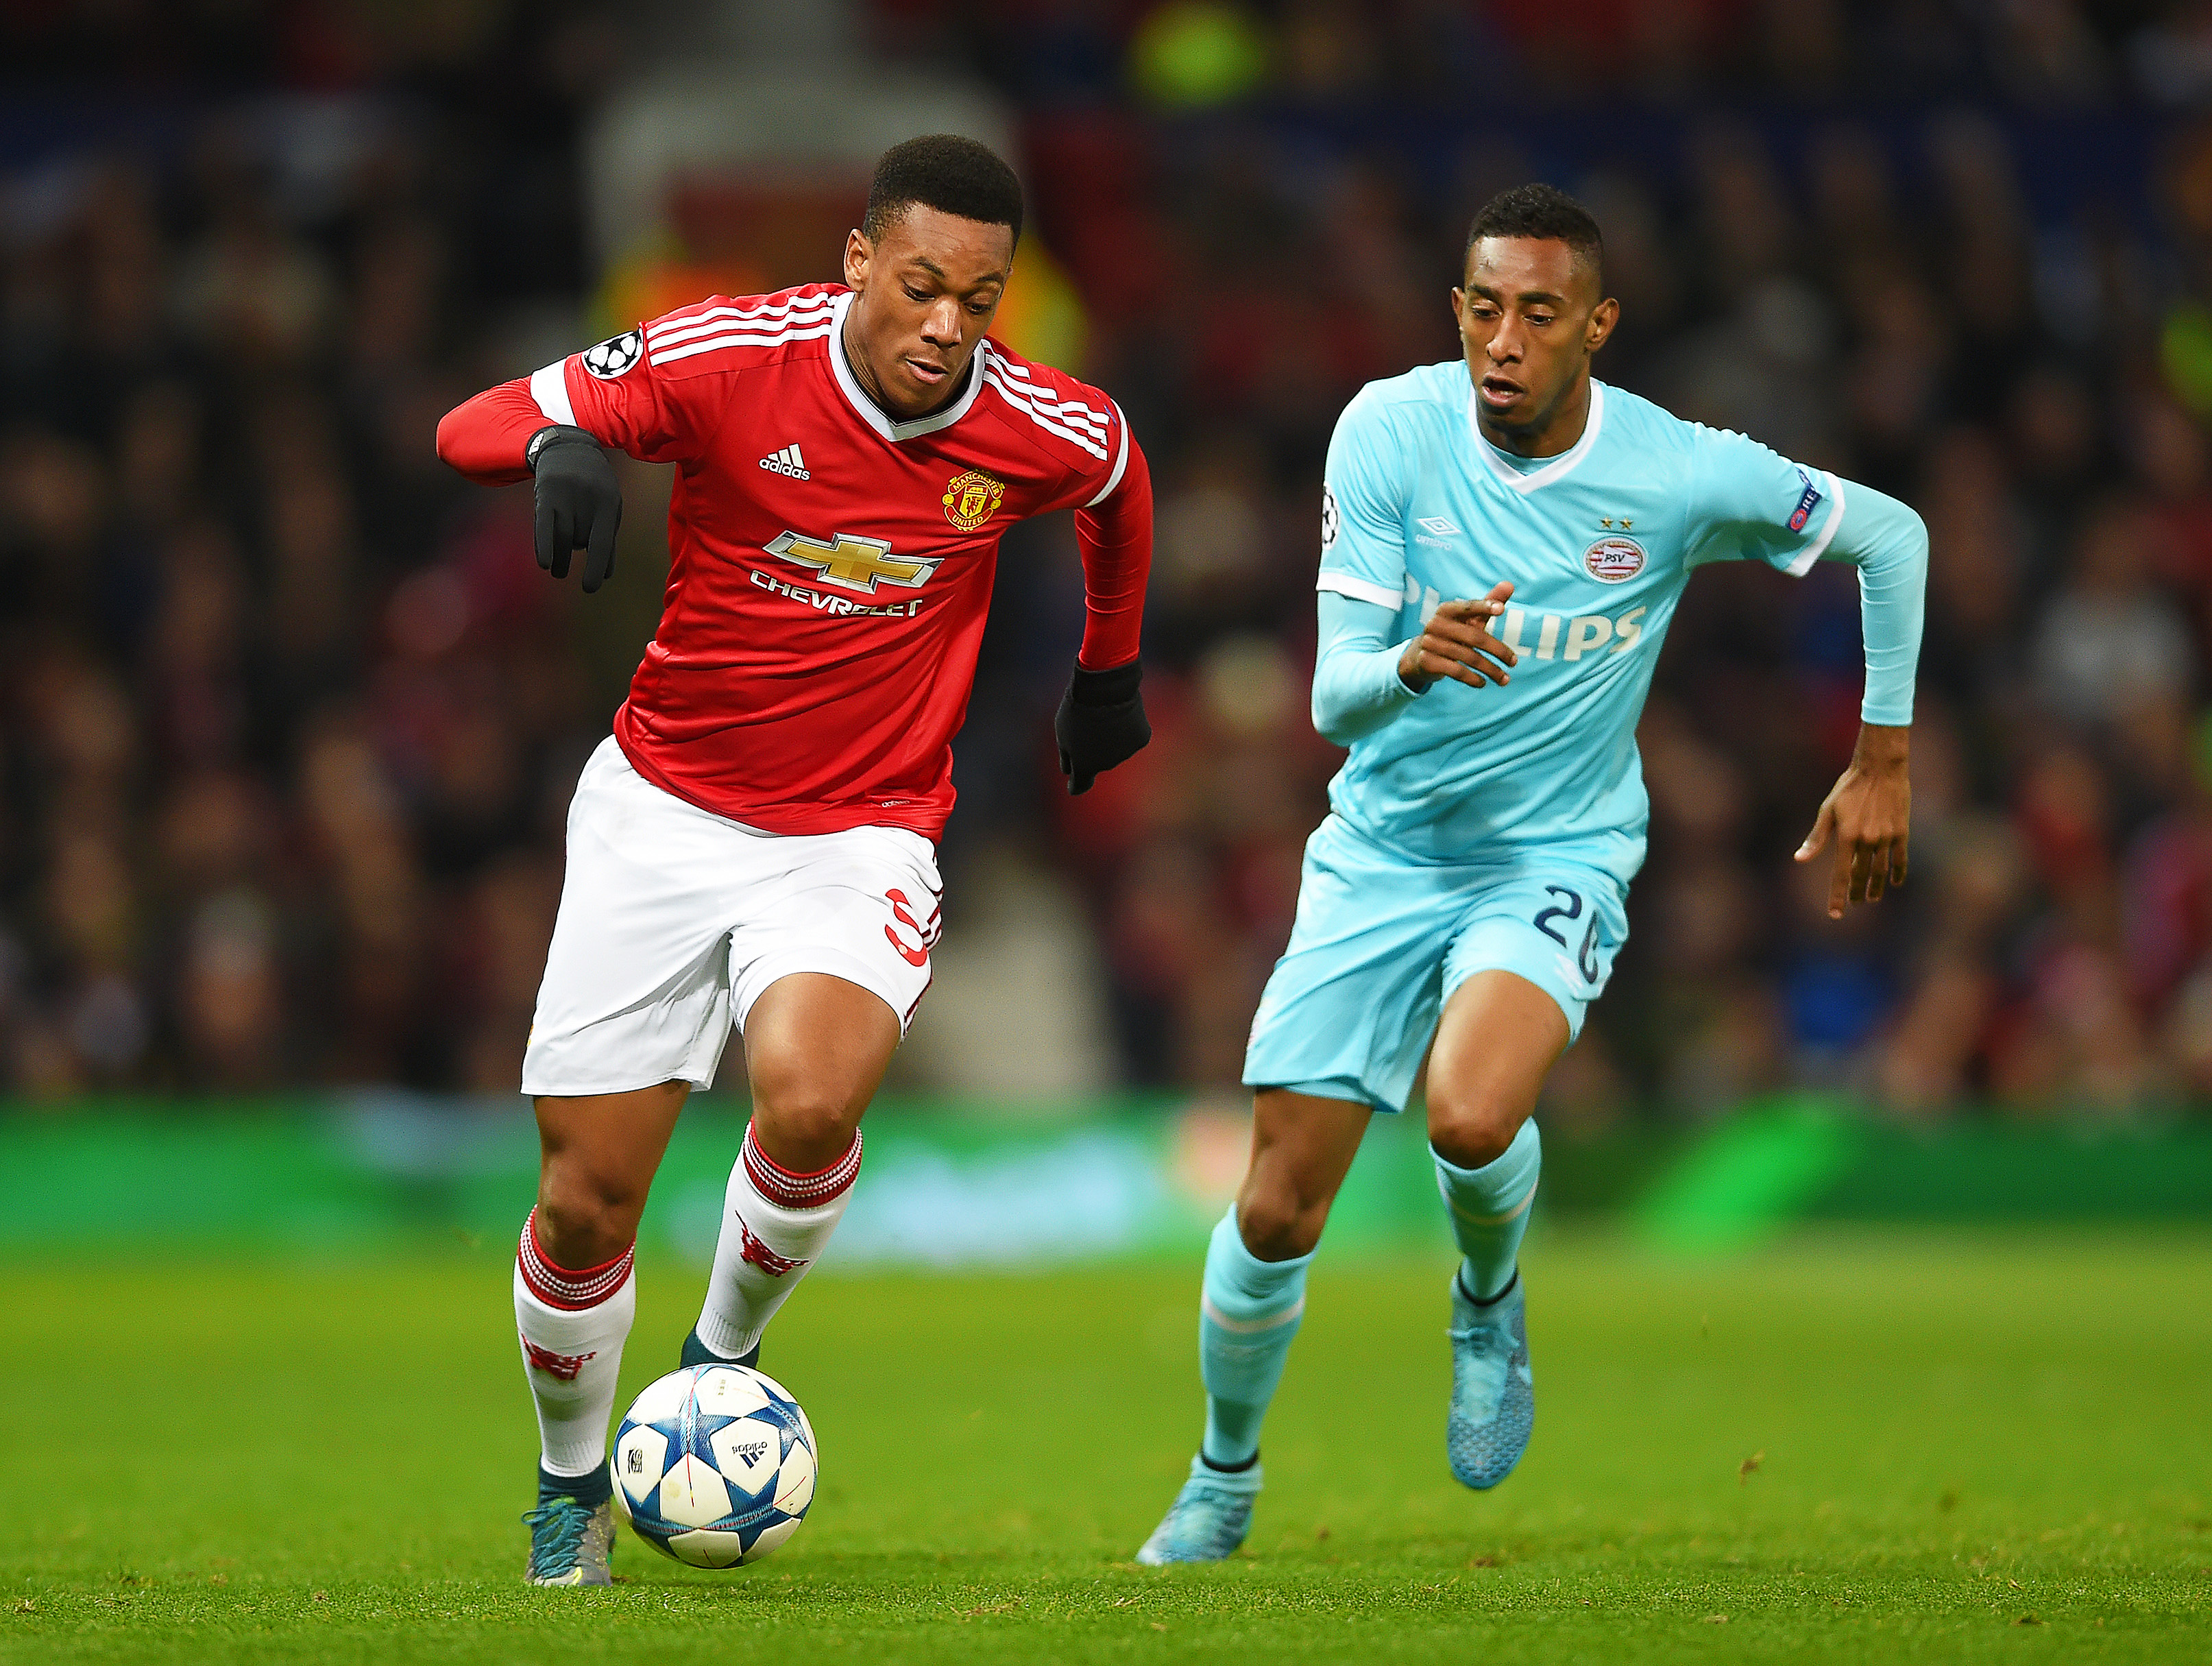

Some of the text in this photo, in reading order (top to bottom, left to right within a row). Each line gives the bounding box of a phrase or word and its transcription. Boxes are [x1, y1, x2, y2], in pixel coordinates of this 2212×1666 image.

[759, 459, 811, 481] adidas
[952, 472, 1000, 496] MANCHESTER
[952, 514, 984, 527] UNITED
[1603, 553, 1625, 563] PSV
[750, 570, 923, 616] CHEVROLET
